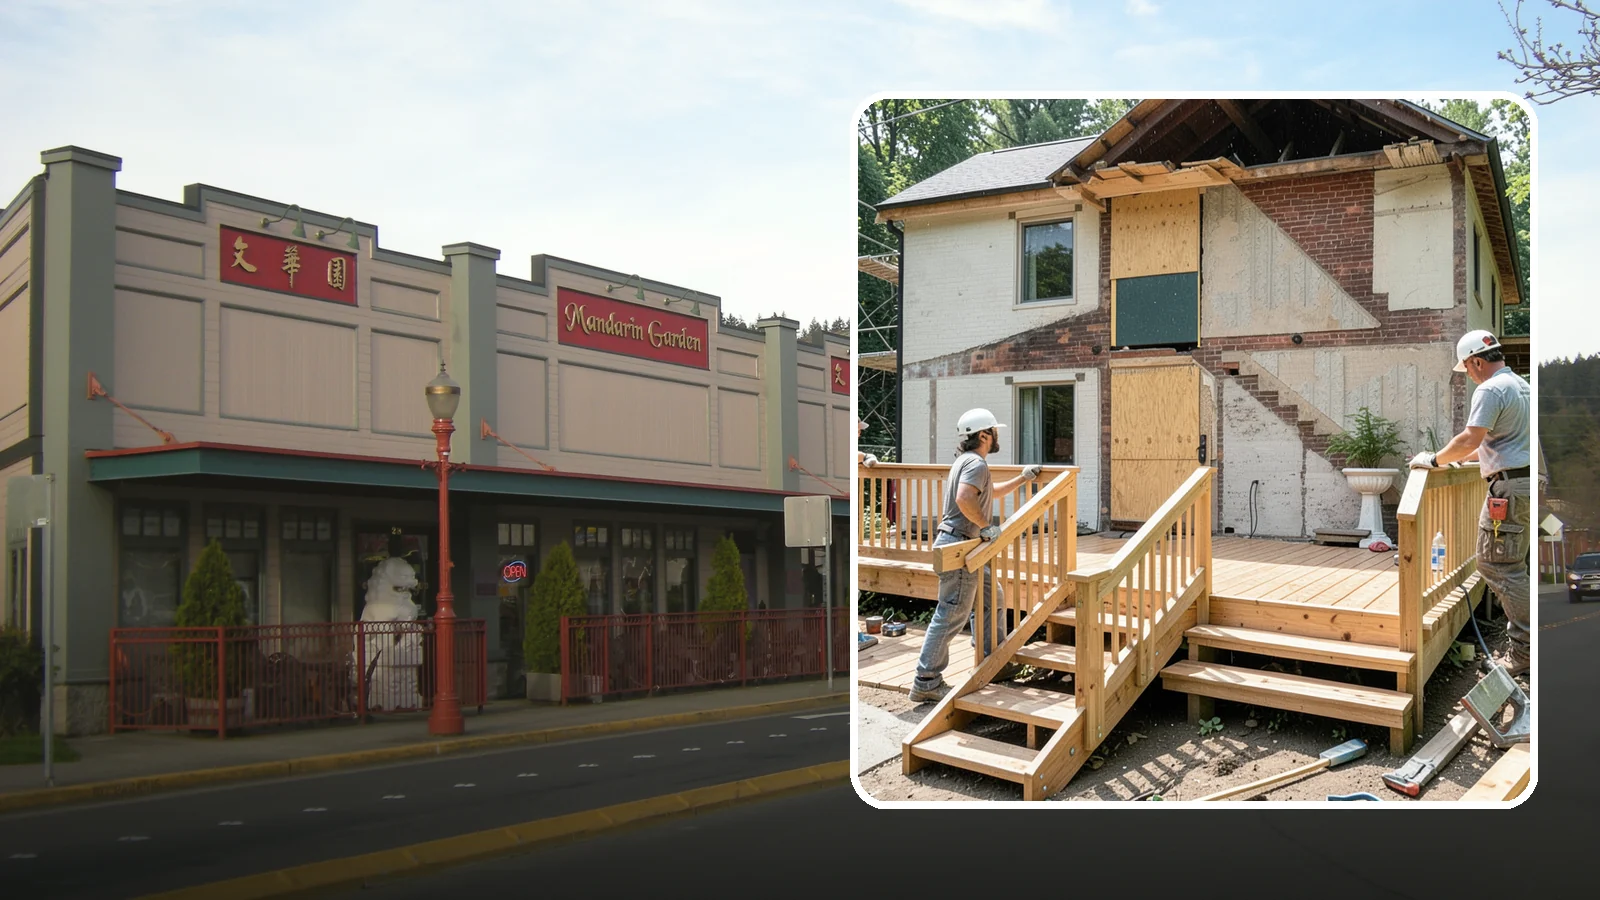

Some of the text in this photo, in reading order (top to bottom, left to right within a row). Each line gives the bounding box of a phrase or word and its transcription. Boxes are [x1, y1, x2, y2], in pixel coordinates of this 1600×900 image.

[231, 235, 346, 291] 文華園
[564, 302, 702, 352] Mandarin Garden
[503, 565, 527, 578] OPEN
